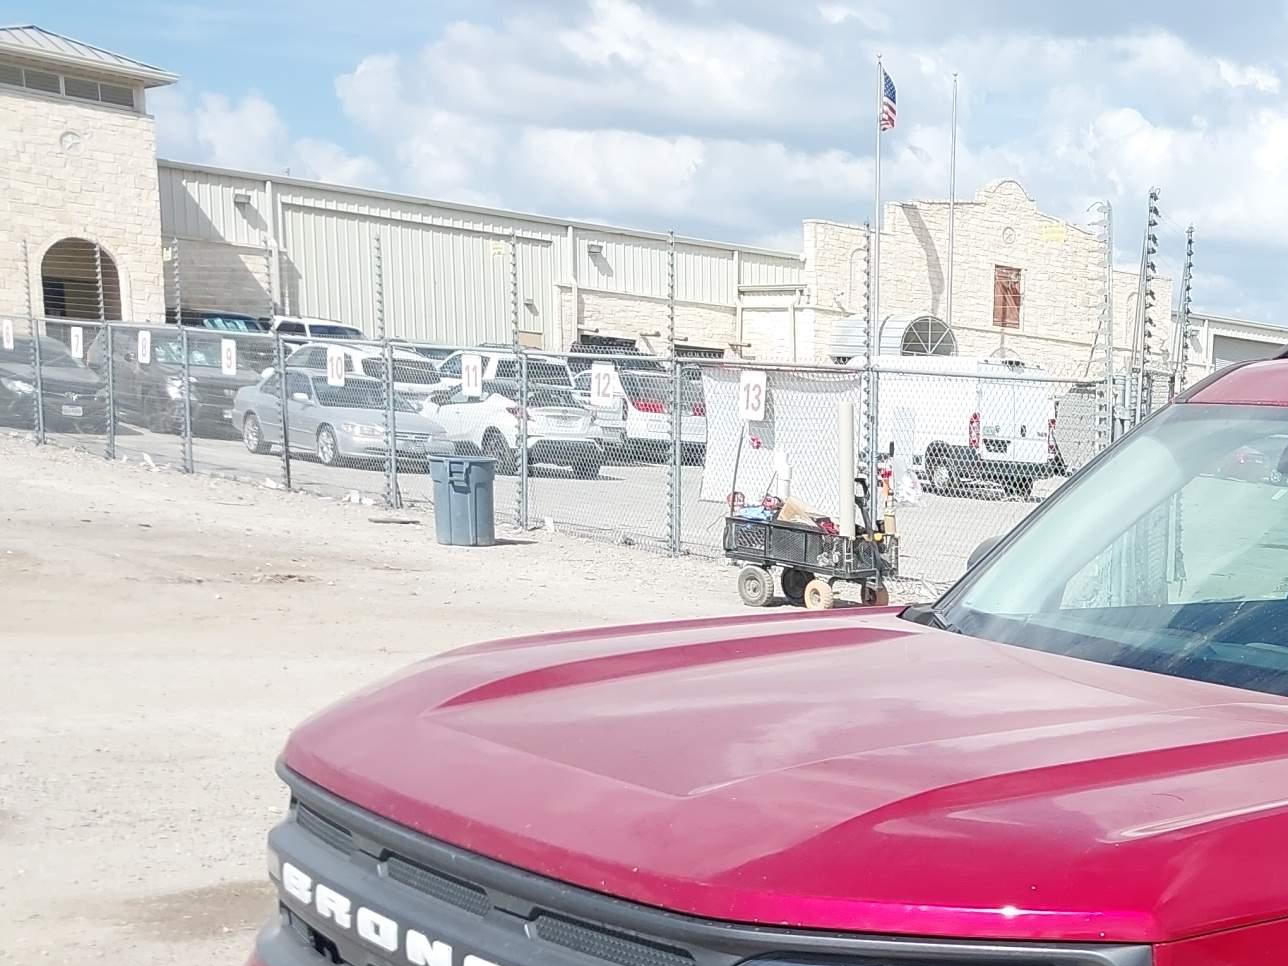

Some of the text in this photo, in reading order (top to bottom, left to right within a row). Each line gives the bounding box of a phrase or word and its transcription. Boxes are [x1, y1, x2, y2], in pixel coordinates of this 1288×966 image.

[329, 355, 344, 380] 10
[465, 364, 479, 388] 11
[594, 372, 611, 398] 12
[744, 383, 762, 412] 13
